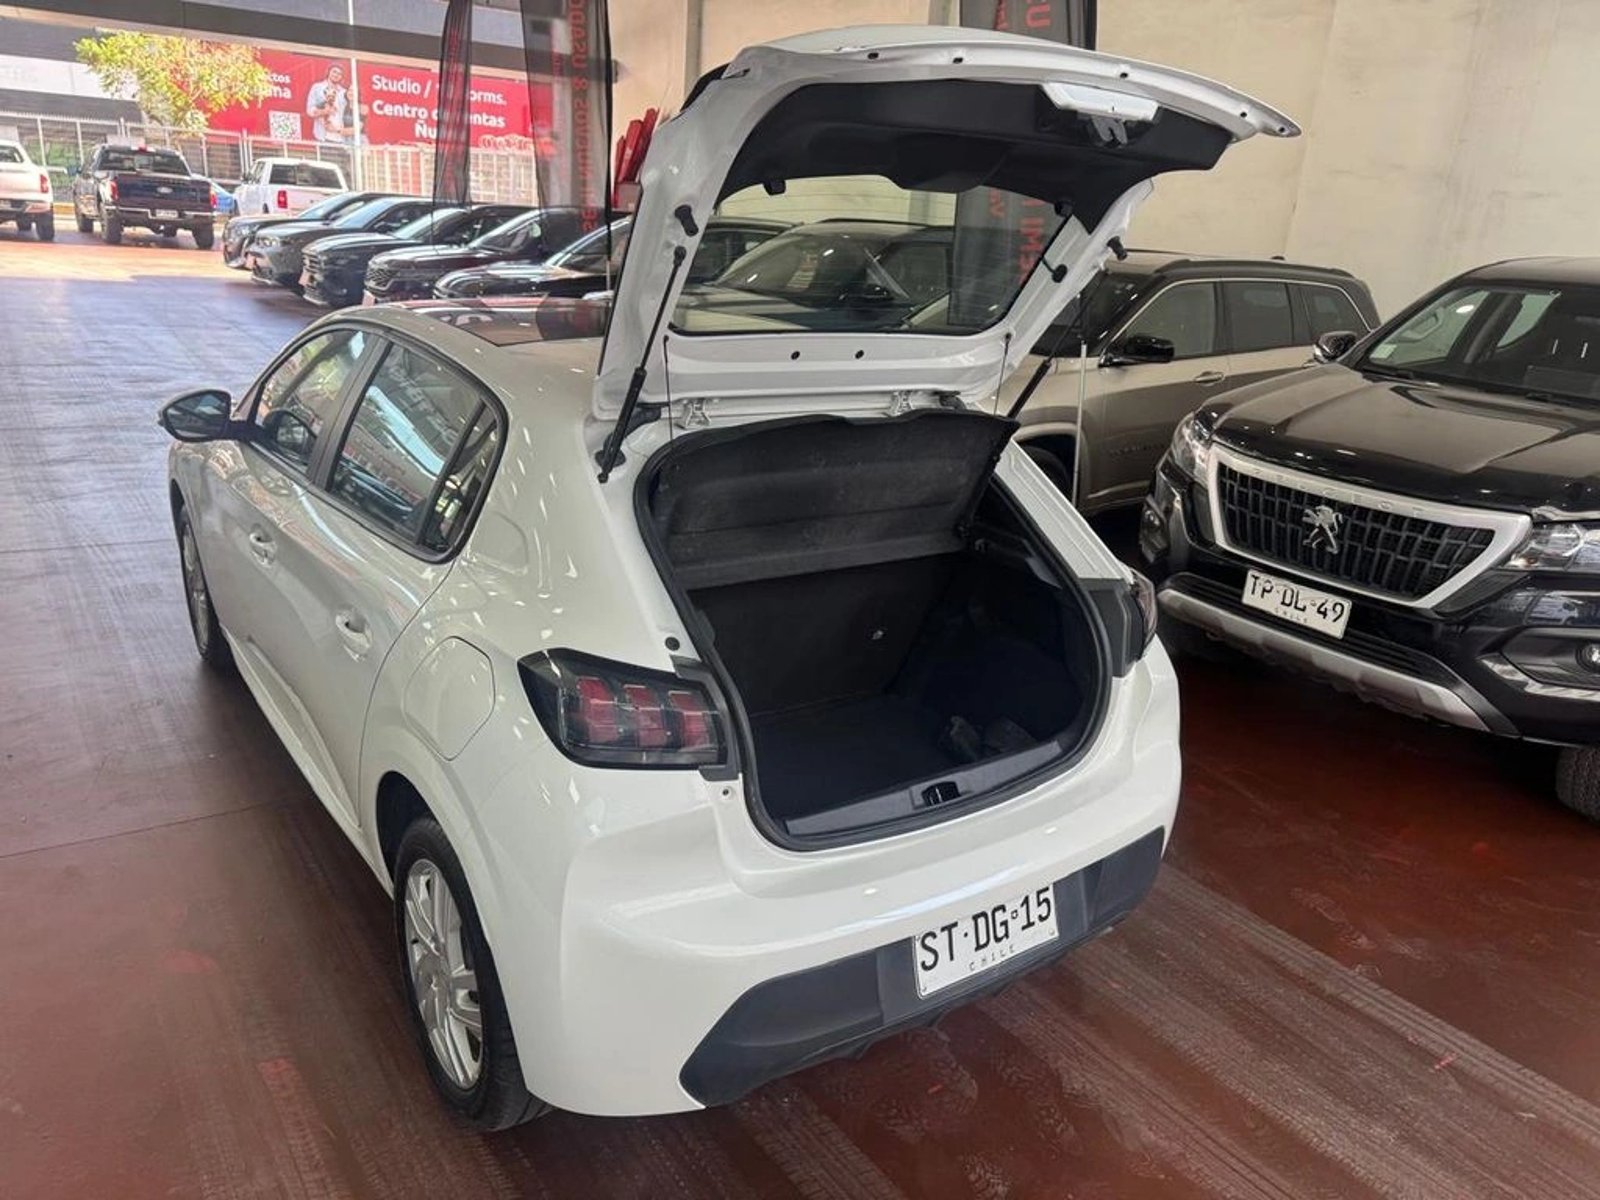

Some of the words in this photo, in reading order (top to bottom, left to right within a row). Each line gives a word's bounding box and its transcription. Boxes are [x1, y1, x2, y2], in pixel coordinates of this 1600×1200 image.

[371, 75, 421, 95] Studio
[468, 89, 508, 106] orms.
[371, 100, 429, 120] Centro
[968, 944, 1015, 972] CHILE
